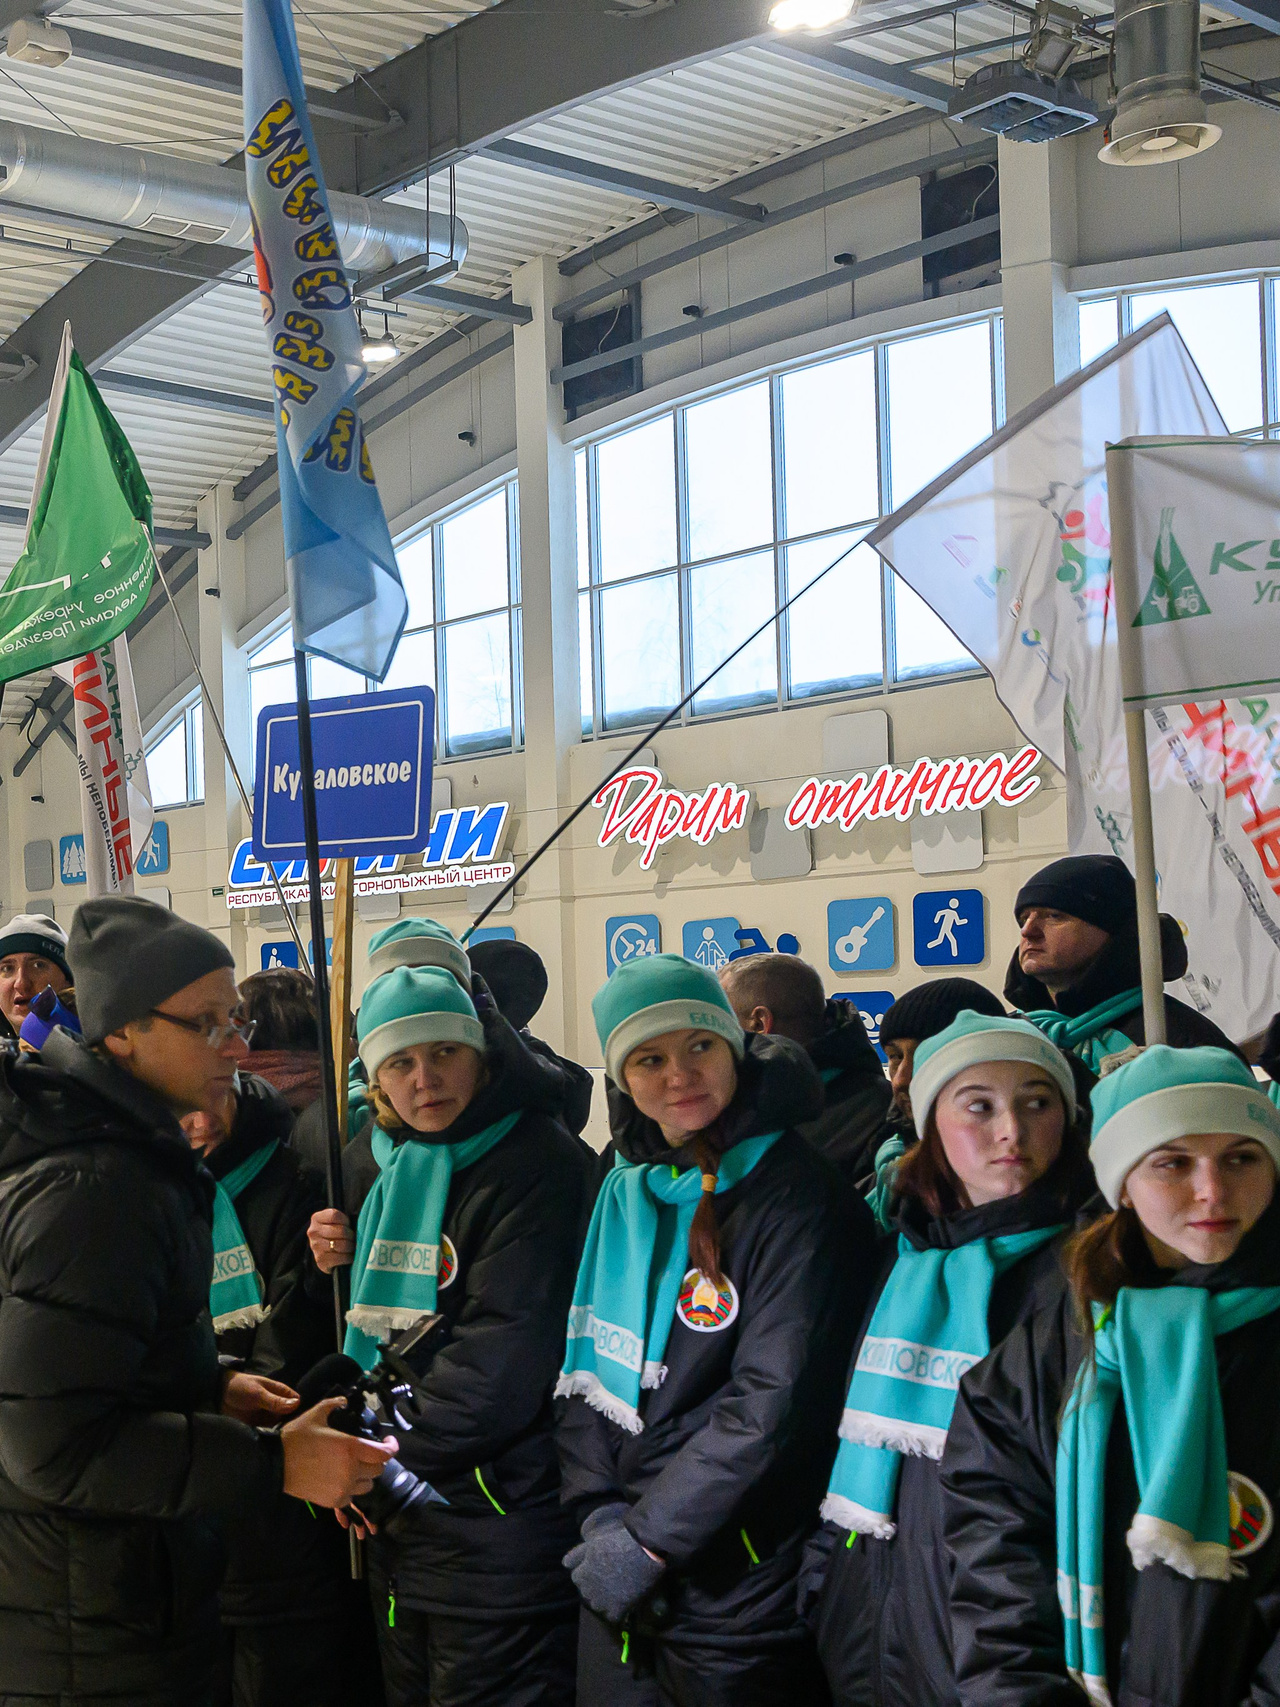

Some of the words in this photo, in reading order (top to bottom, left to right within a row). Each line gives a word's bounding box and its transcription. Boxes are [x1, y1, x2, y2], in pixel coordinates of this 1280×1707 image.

[273, 760, 413, 801] Куаловское
[596, 771, 748, 865] Дарим
[786, 748, 1038, 827] отличное
[463, 866, 512, 888] ЦЕНТР
[635, 938, 657, 956] 24
